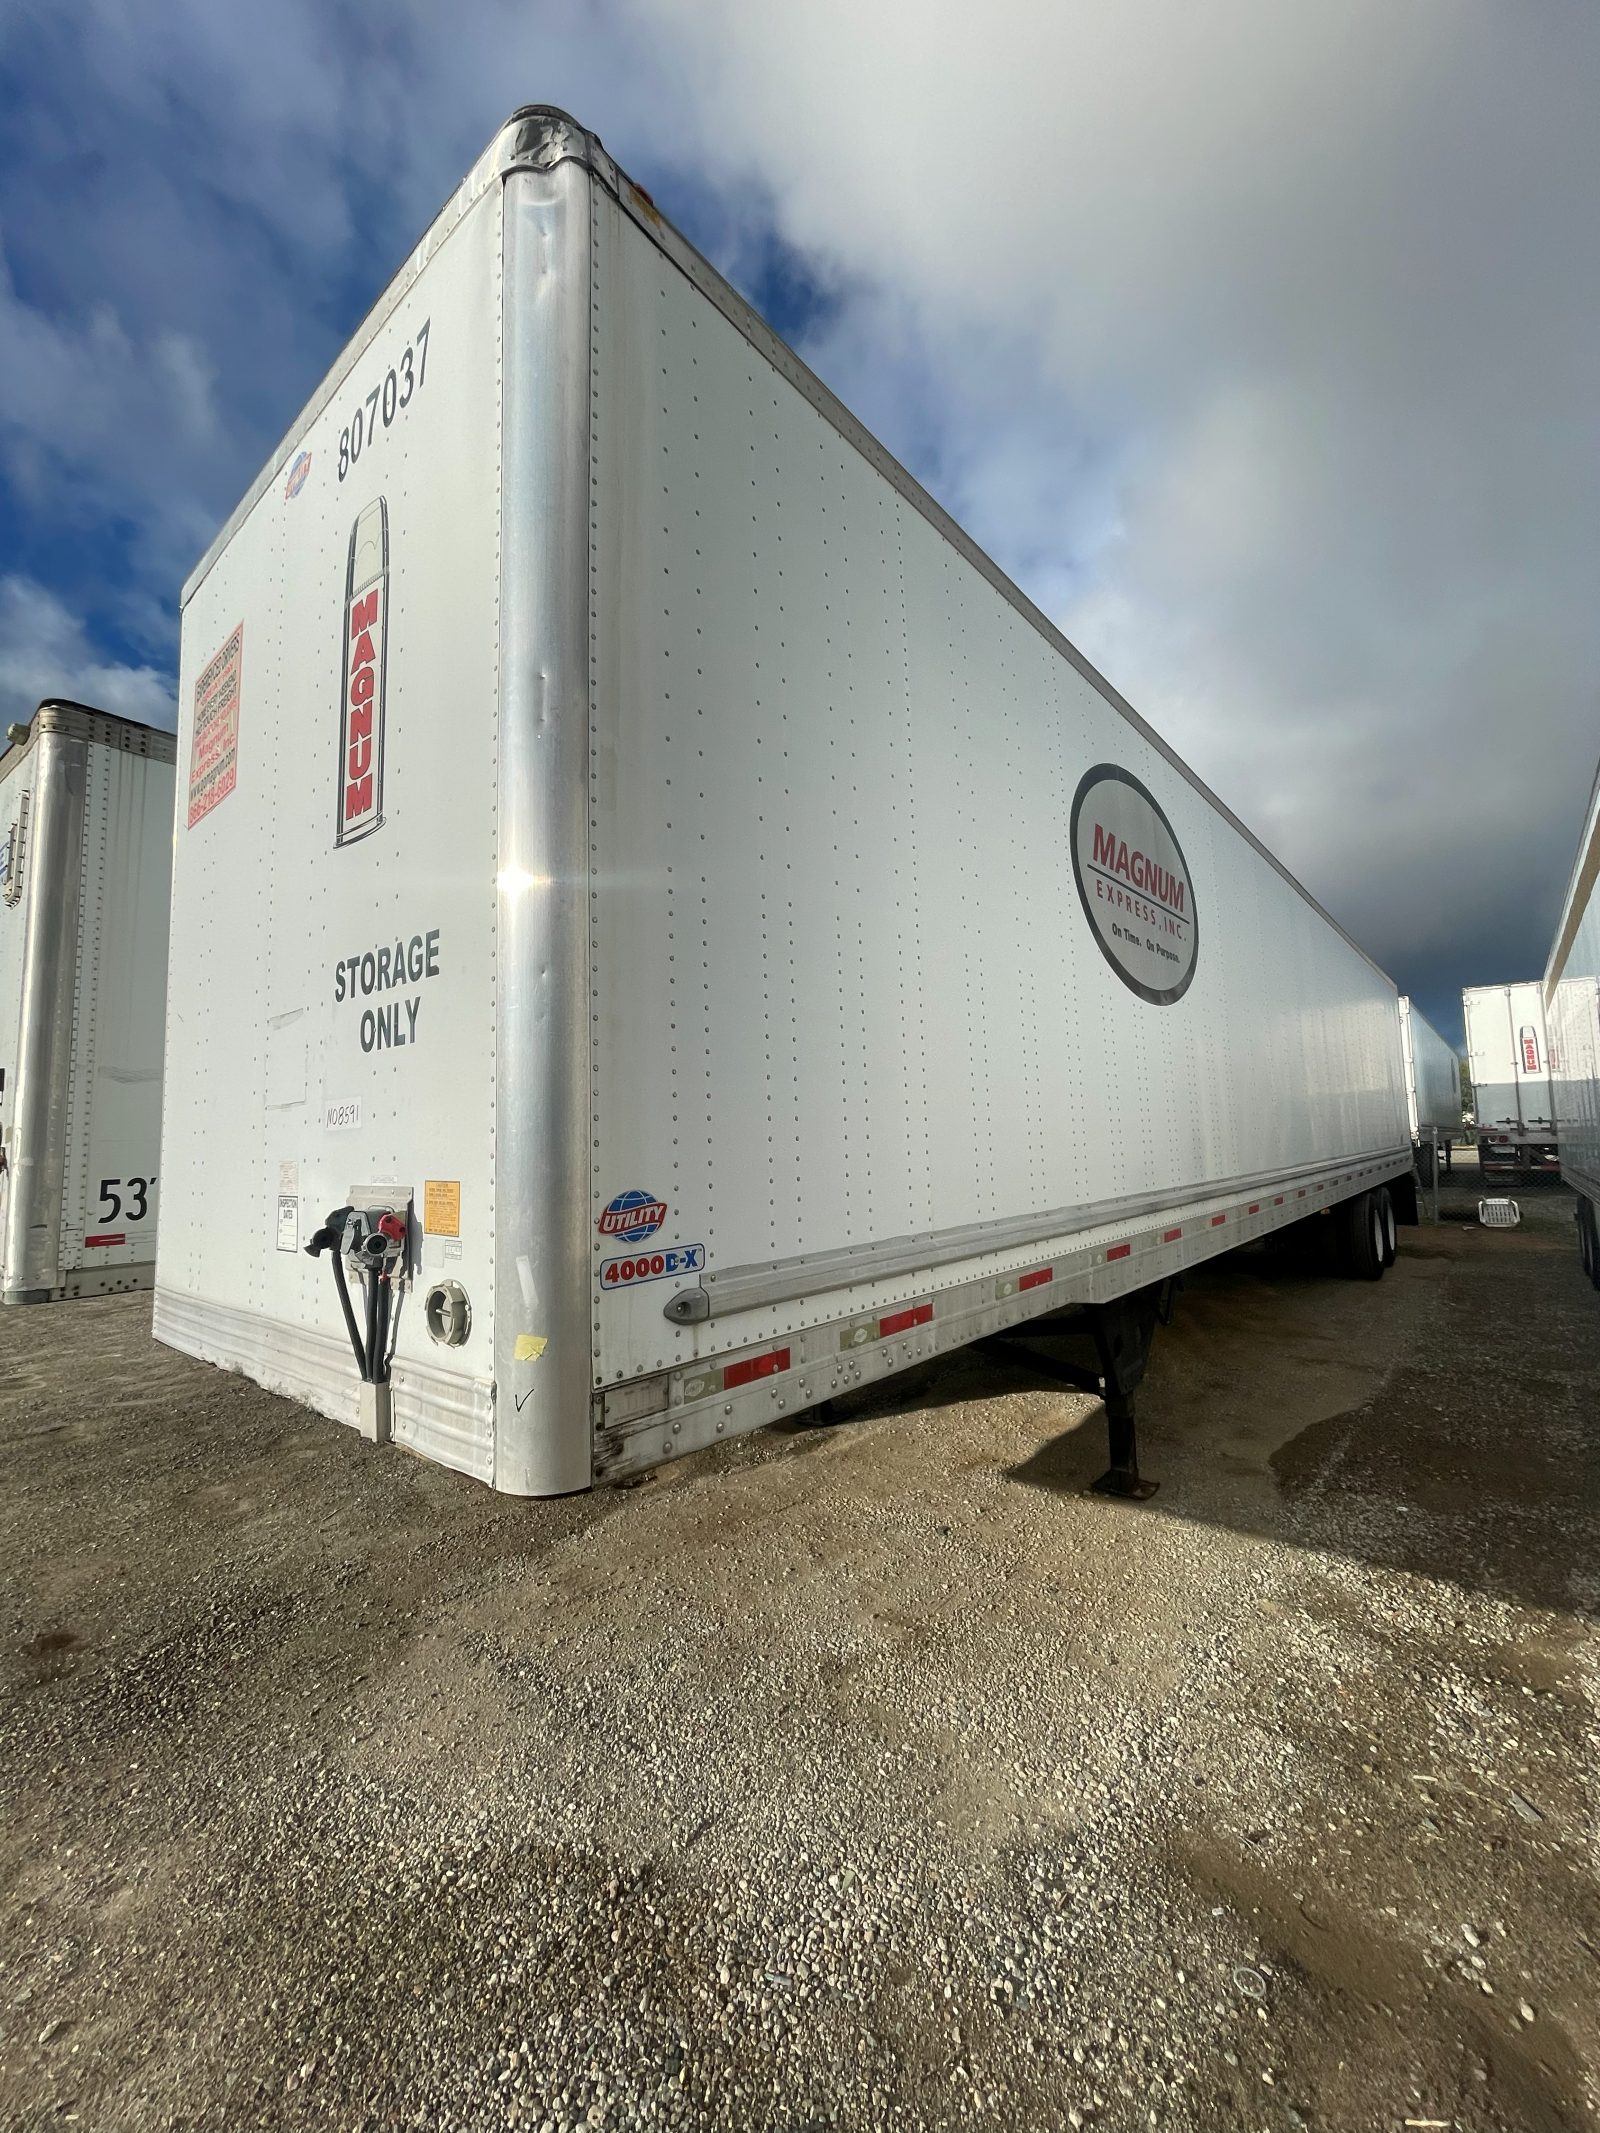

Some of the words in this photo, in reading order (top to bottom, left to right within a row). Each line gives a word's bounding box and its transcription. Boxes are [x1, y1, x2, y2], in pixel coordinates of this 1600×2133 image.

[338, 315, 431, 483] 807037
[345, 588, 379, 821] MAGNUM
[1092, 823, 1185, 913] MAGNUM
[334, 928, 440, 1003] STORAGE
[1112, 922, 1122, 939] On
[1146, 938, 1155, 953] On
[360, 995, 422, 1053] ONLY
[97, 1176, 158, 1224] 53'
[602, 1205, 664, 1232] UTILITY
[604, 1248, 699, 1284] 4000D-X
